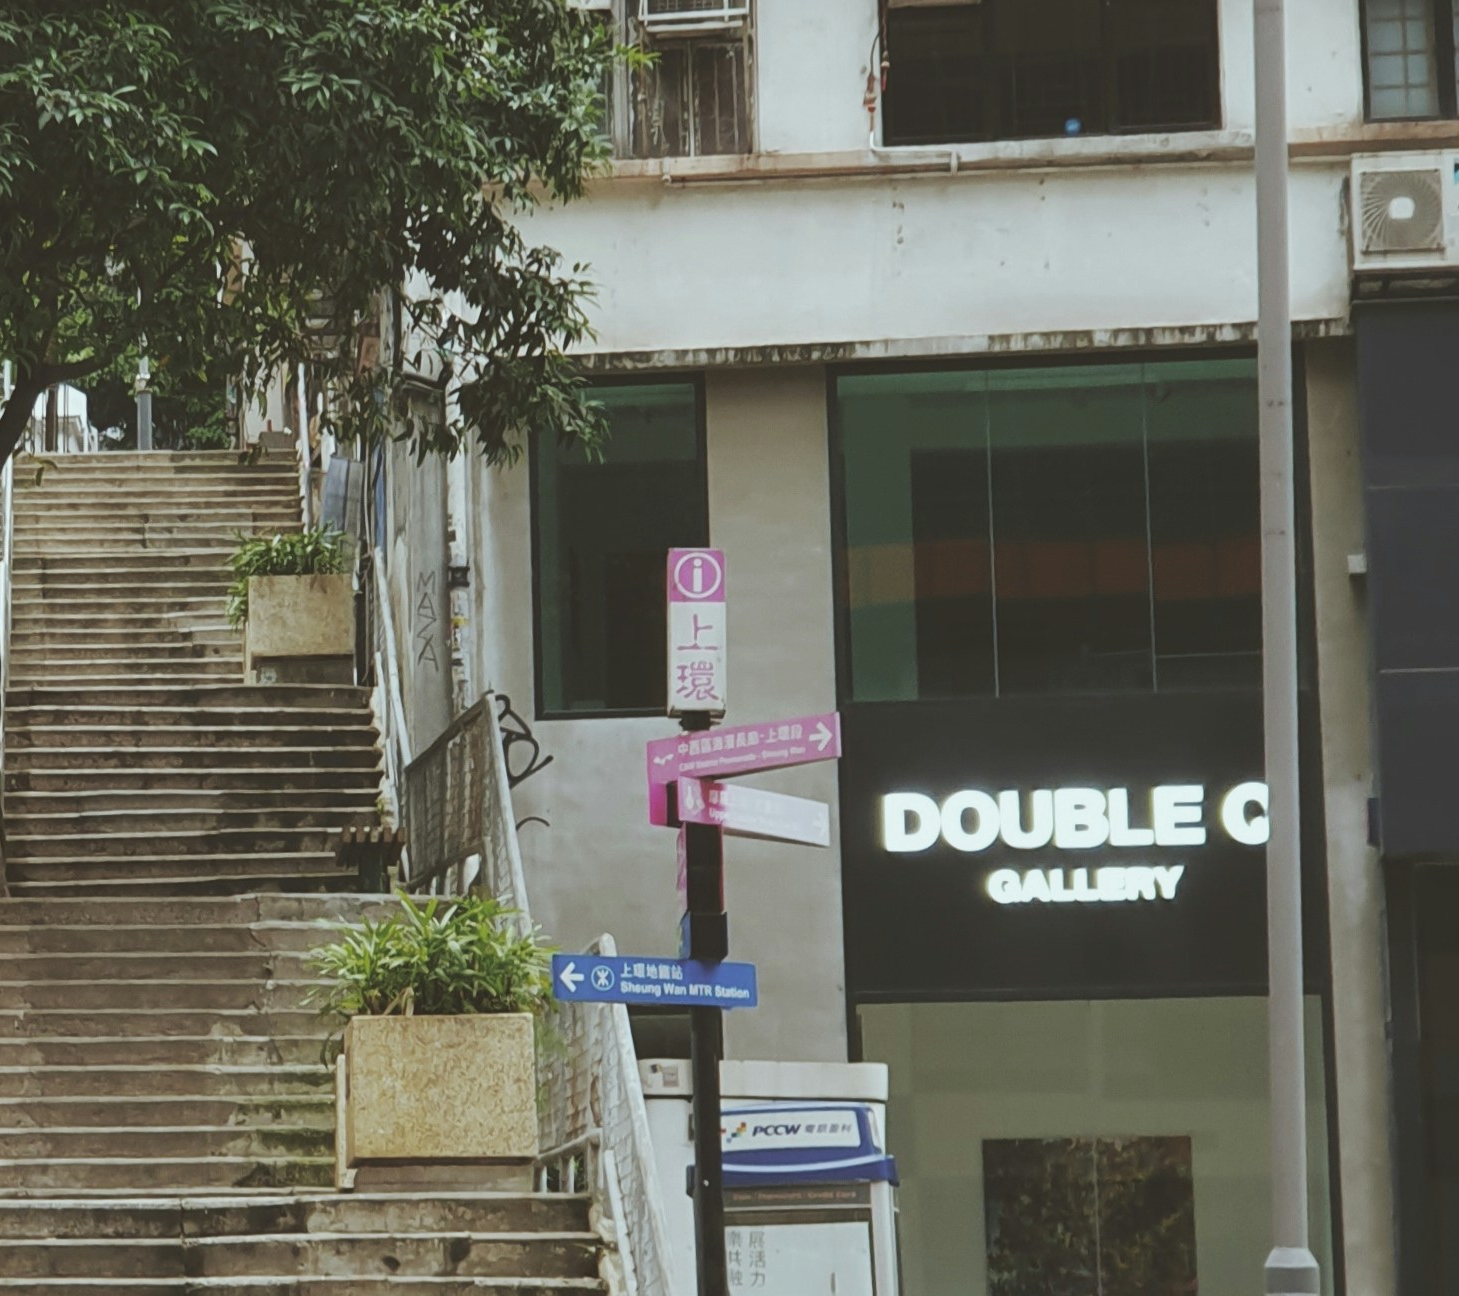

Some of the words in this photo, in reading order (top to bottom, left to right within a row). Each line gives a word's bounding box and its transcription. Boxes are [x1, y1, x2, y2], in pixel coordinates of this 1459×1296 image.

[676, 613, 719, 702] 上環
[882, 784, 1207, 853] DOUBLE
[987, 865, 1185, 904] GALLERY
[620, 981, 662, 998] Sheung
[663, 982, 687, 996] Wan
[689, 984, 713, 997] MTR
[714, 984, 751, 1000] Station
[752, 1123, 802, 1137] PCCW
